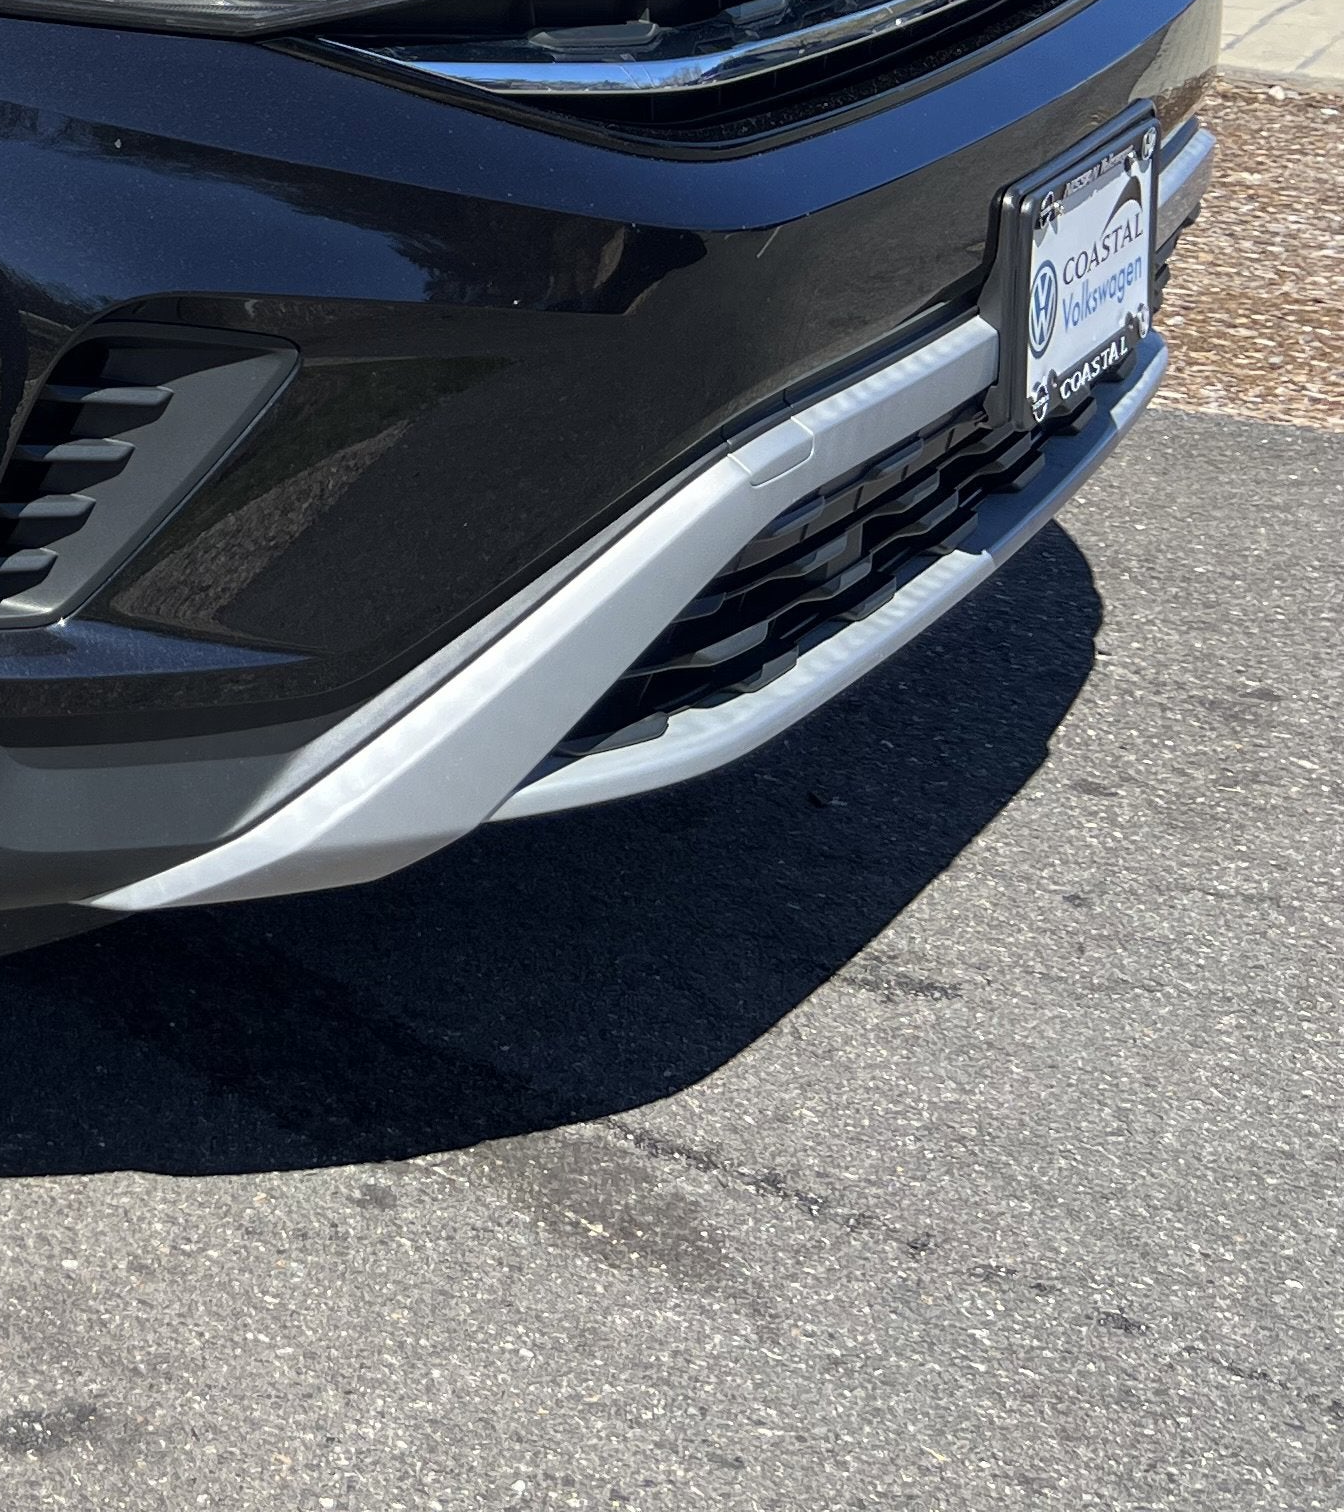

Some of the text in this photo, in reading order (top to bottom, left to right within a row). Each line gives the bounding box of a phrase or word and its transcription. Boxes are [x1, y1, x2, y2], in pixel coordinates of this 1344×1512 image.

[1062, 211, 1144, 286] COASTAL
[1061, 254, 1143, 333] Volkswagen
[1059, 337, 1129, 401] COASTAL
